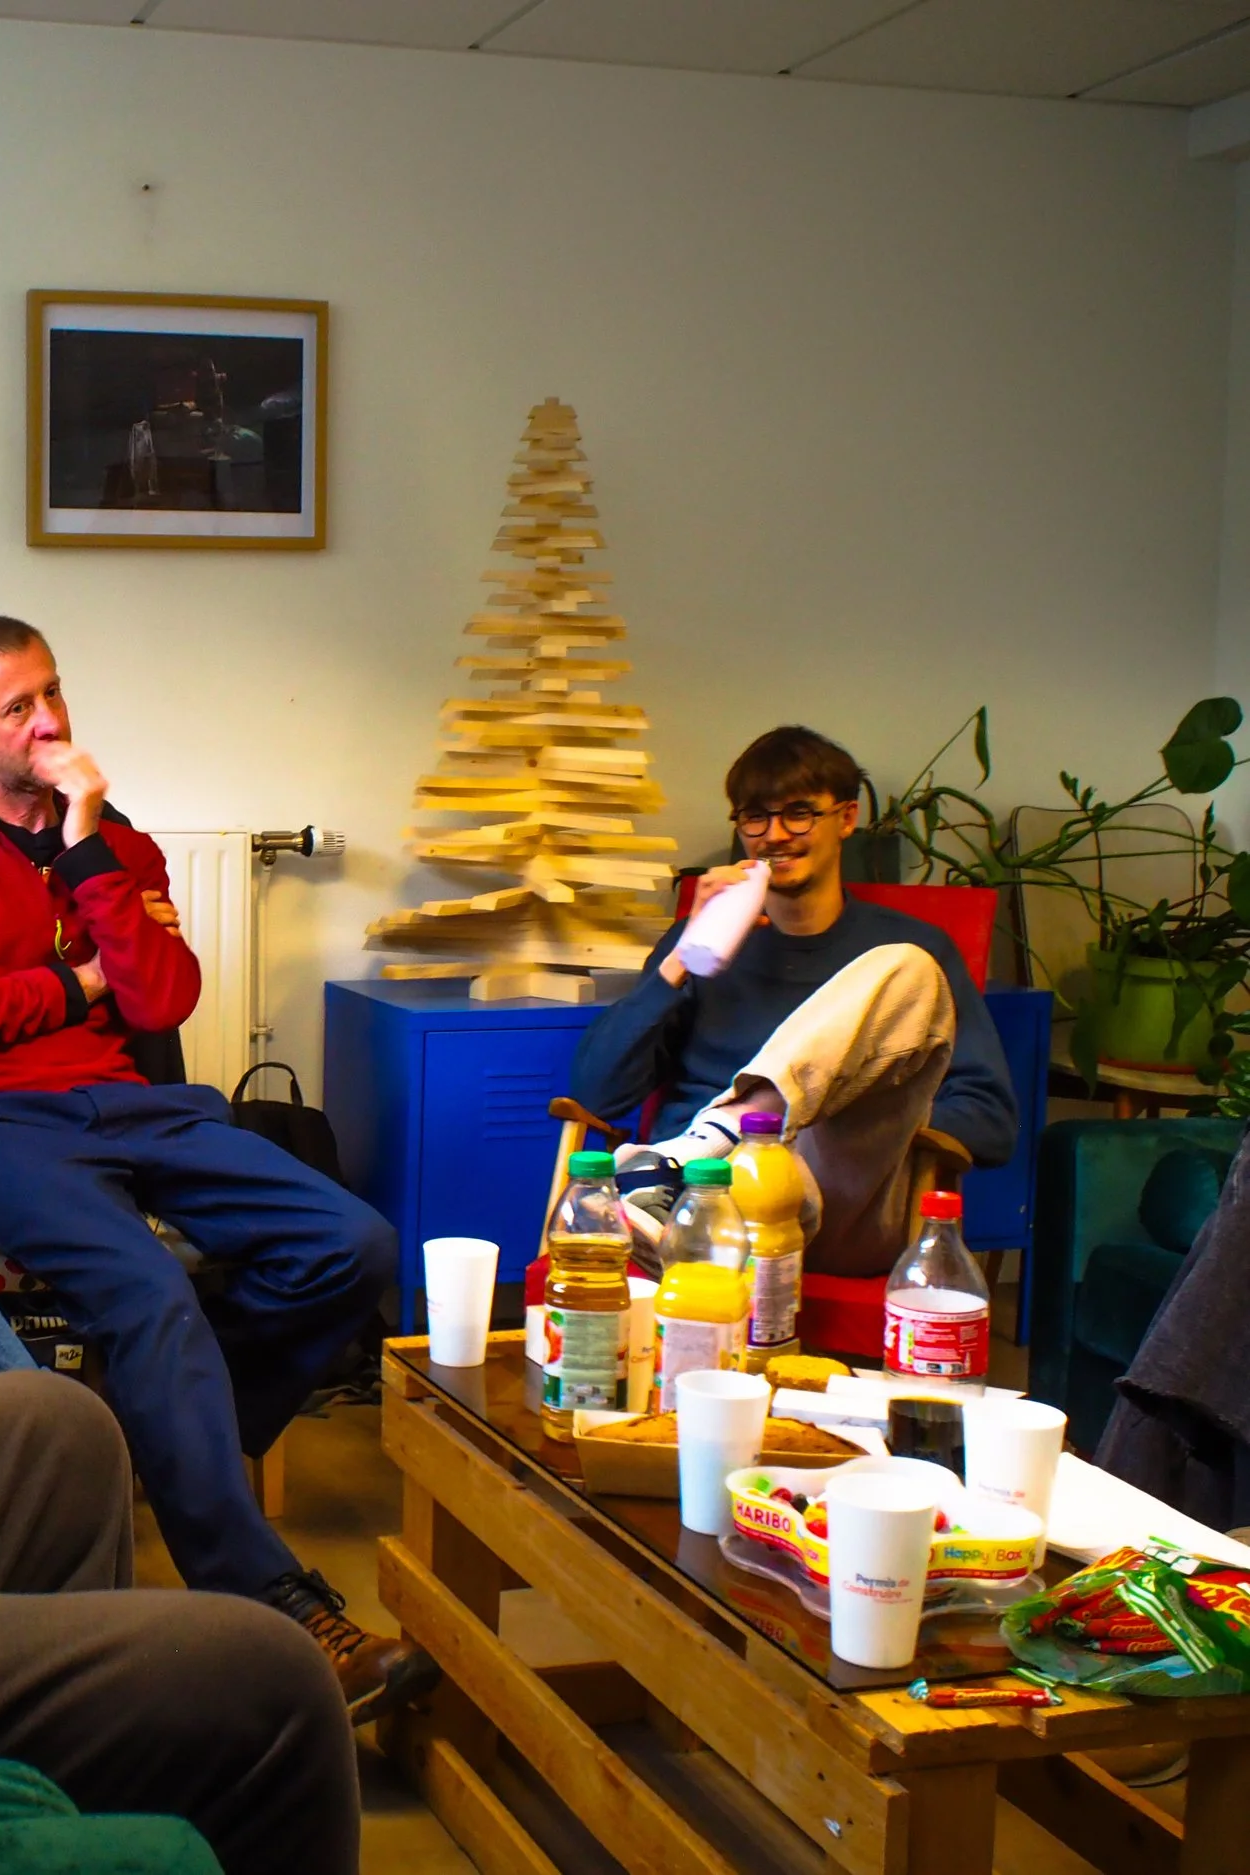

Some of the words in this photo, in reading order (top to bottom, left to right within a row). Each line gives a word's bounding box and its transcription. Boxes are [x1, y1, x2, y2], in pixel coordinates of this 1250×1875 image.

[734, 1499, 791, 1533] HARIBO
[944, 1546, 990, 1565] Happy
[996, 1547, 1023, 1562] Box
[855, 1572, 897, 1589] Permis
